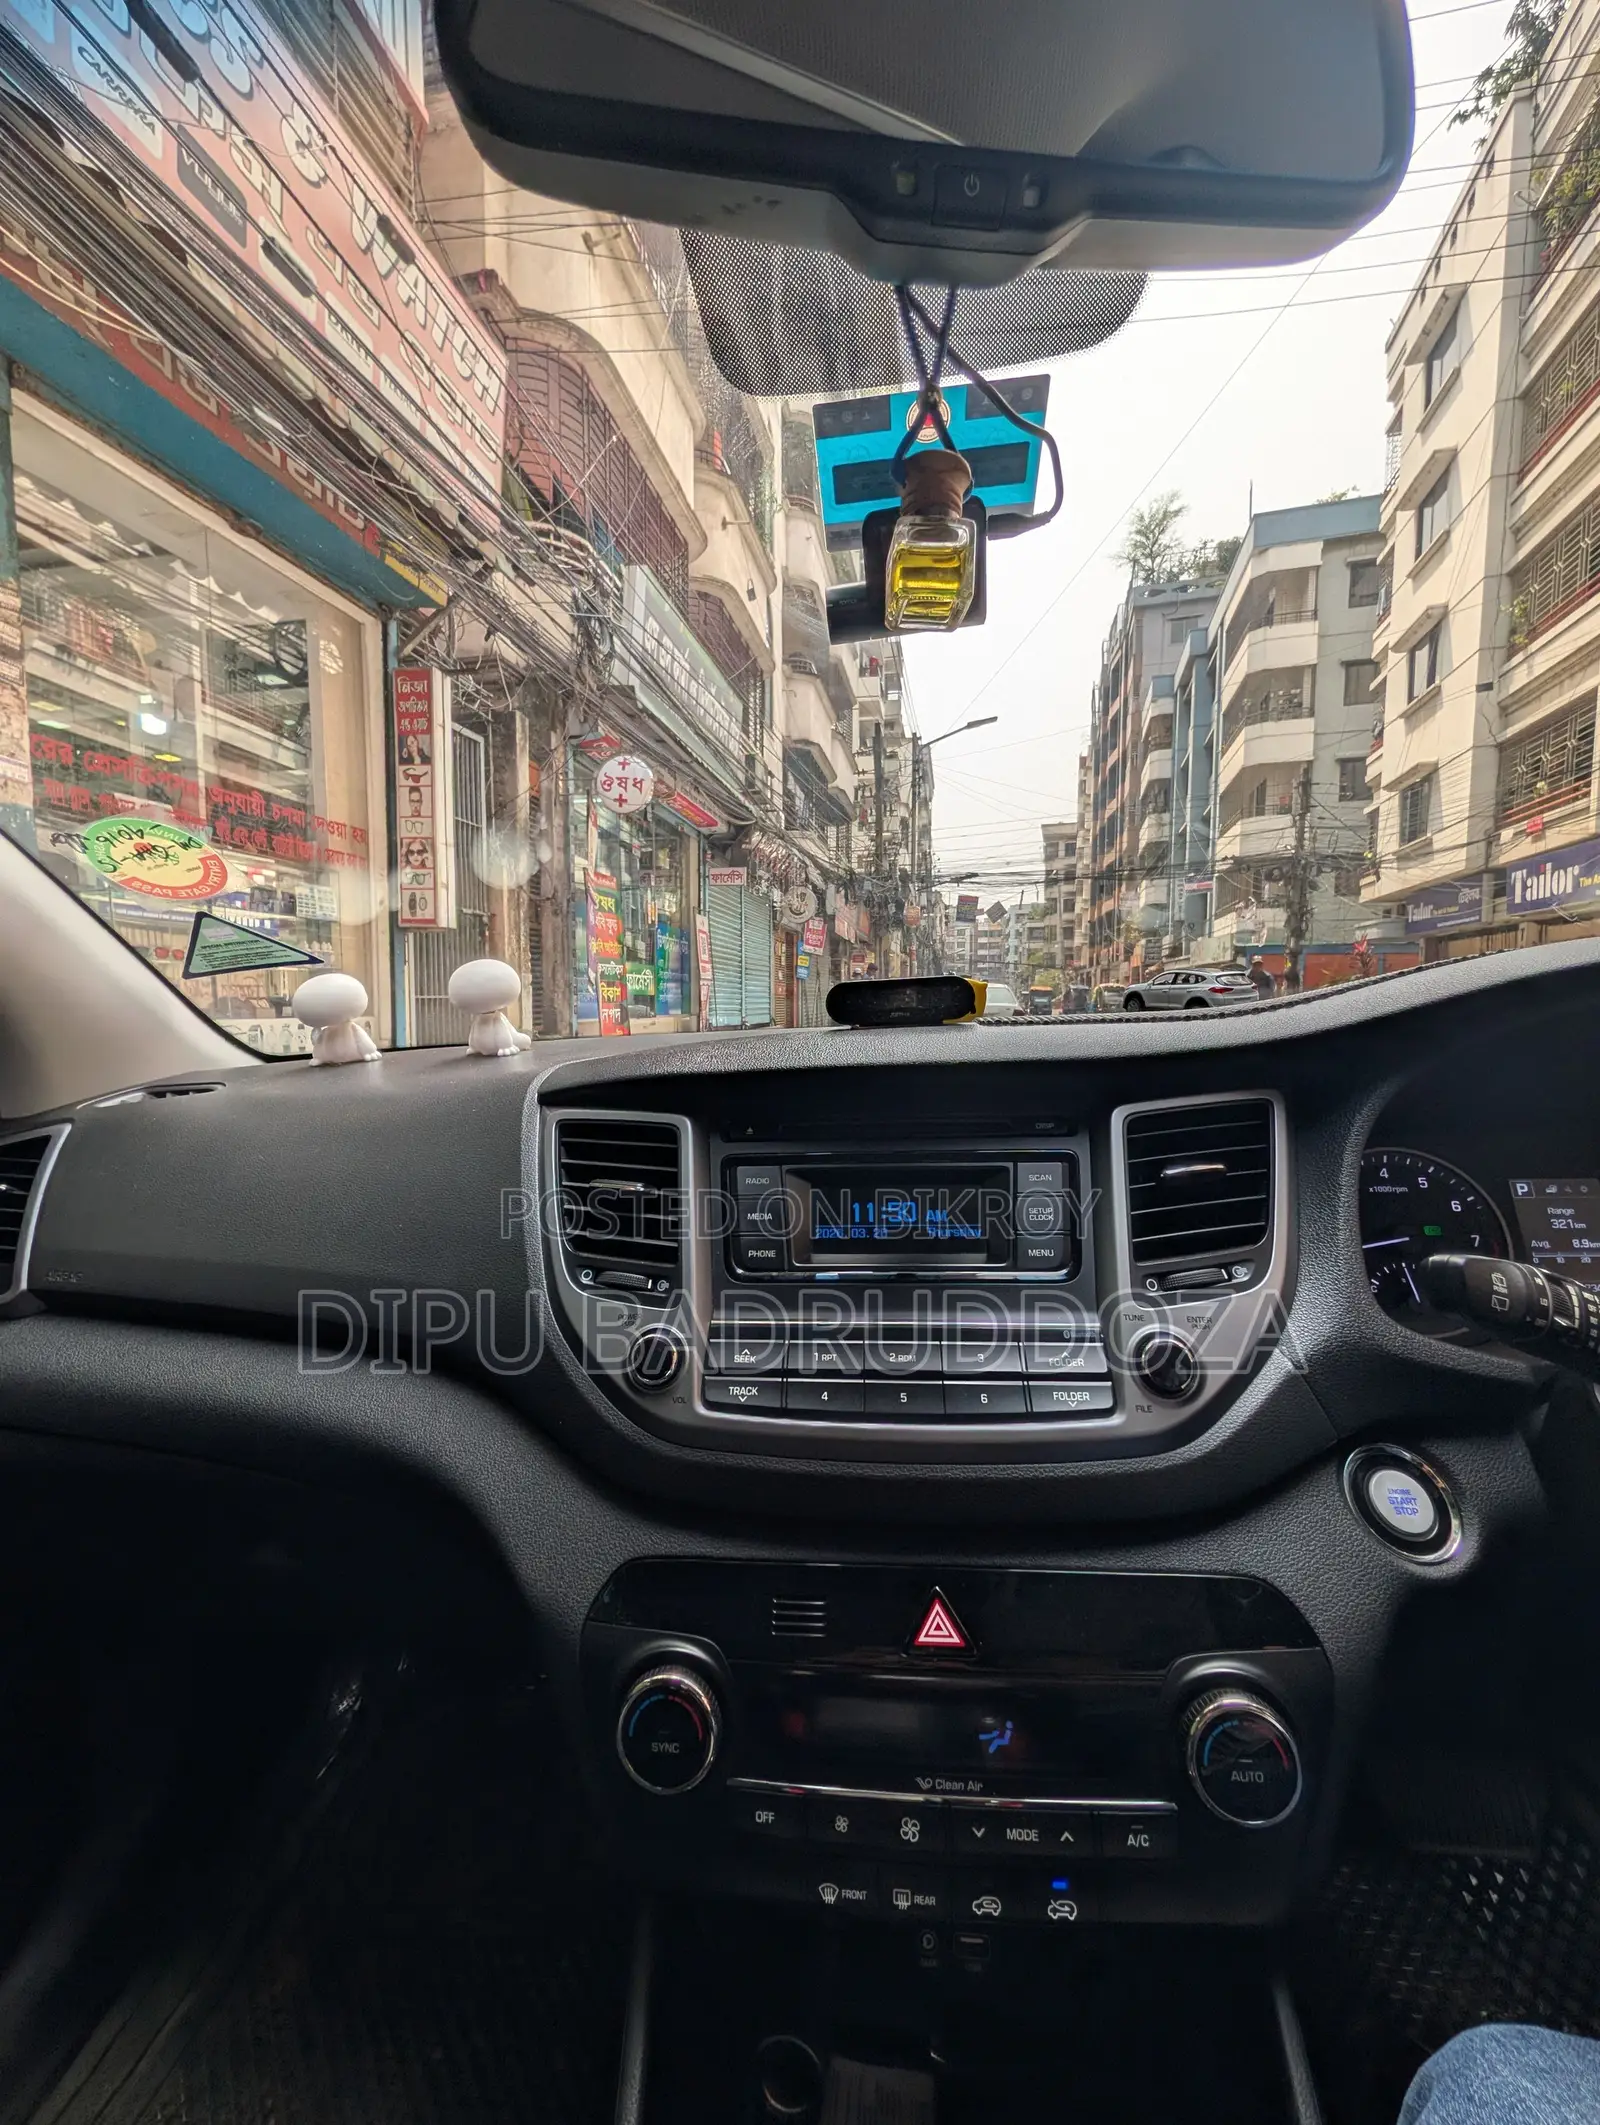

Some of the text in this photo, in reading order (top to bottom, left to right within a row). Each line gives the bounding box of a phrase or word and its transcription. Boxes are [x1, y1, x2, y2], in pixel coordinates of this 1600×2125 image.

[77, 45, 157, 137] CARRERA
[351, 172, 503, 416] WATCH
[600, 772, 646, 795] ঔষধ
[711, 868, 744, 885] ফার্মেসি
[1511, 862, 1581, 905] Tailor
[1407, 902, 1434, 924] Tailor
[1028, 1173, 1053, 1182] SCAN
[1379, 1168, 1389, 1179] 4
[745, 1176, 770, 1185] RADIO
[1417, 1177, 1429, 1189] 5
[1516, 1183, 1529, 1196] P
[1028, 1206, 1054, 1214] SETUP
[1450, 1200, 1462, 1212] 6
[1547, 1207, 1575, 1216] Range
[747, 1211, 773, 1221] MEDIA
[852, 1201, 948, 1223] 11:50 AM
[1029, 1213, 1054, 1221] CLOCK
[1470, 1234, 1480, 1248] 7
[748, 1249, 777, 1258] PHONE
[1028, 1248, 1055, 1257] MENU
[1532, 1256, 1591, 1265] 0 10 20
[1123, 1314, 1145, 1322] TUNE
[1186, 1315, 1213, 1324] ENTER
[733, 1354, 757, 1364] SEEK
[821, 1353, 838, 1362] RPT
[889, 1352, 917, 1363] 2 RDM
[977, 1353, 985, 1363] 3
[1049, 1357, 1085, 1367] FOLDER
[728, 1386, 758, 1396] TRACK
[821, 1391, 829, 1401] 4
[1053, 1391, 1090, 1402] FOLDER
[672, 1396, 687, 1405] VOL
[900, 1392, 908, 1403] 5
[980, 1393, 988, 1404] 6
[1135, 1404, 1153, 1414] FILE
[1387, 1496, 1418, 1507] START
[1394, 1506, 1419, 1517] STOP
[651, 1742, 680, 1754] SYNC
[1230, 1770, 1264, 1783] AUTO
[935, 1779, 984, 1792] Clean Air
[755, 1810, 776, 1824] OFF
[1006, 1827, 1040, 1842] MODE
[1126, 1833, 1150, 1848] A/C
[841, 1889, 868, 1900] FRONT
[913, 1894, 936, 1906] REAR
